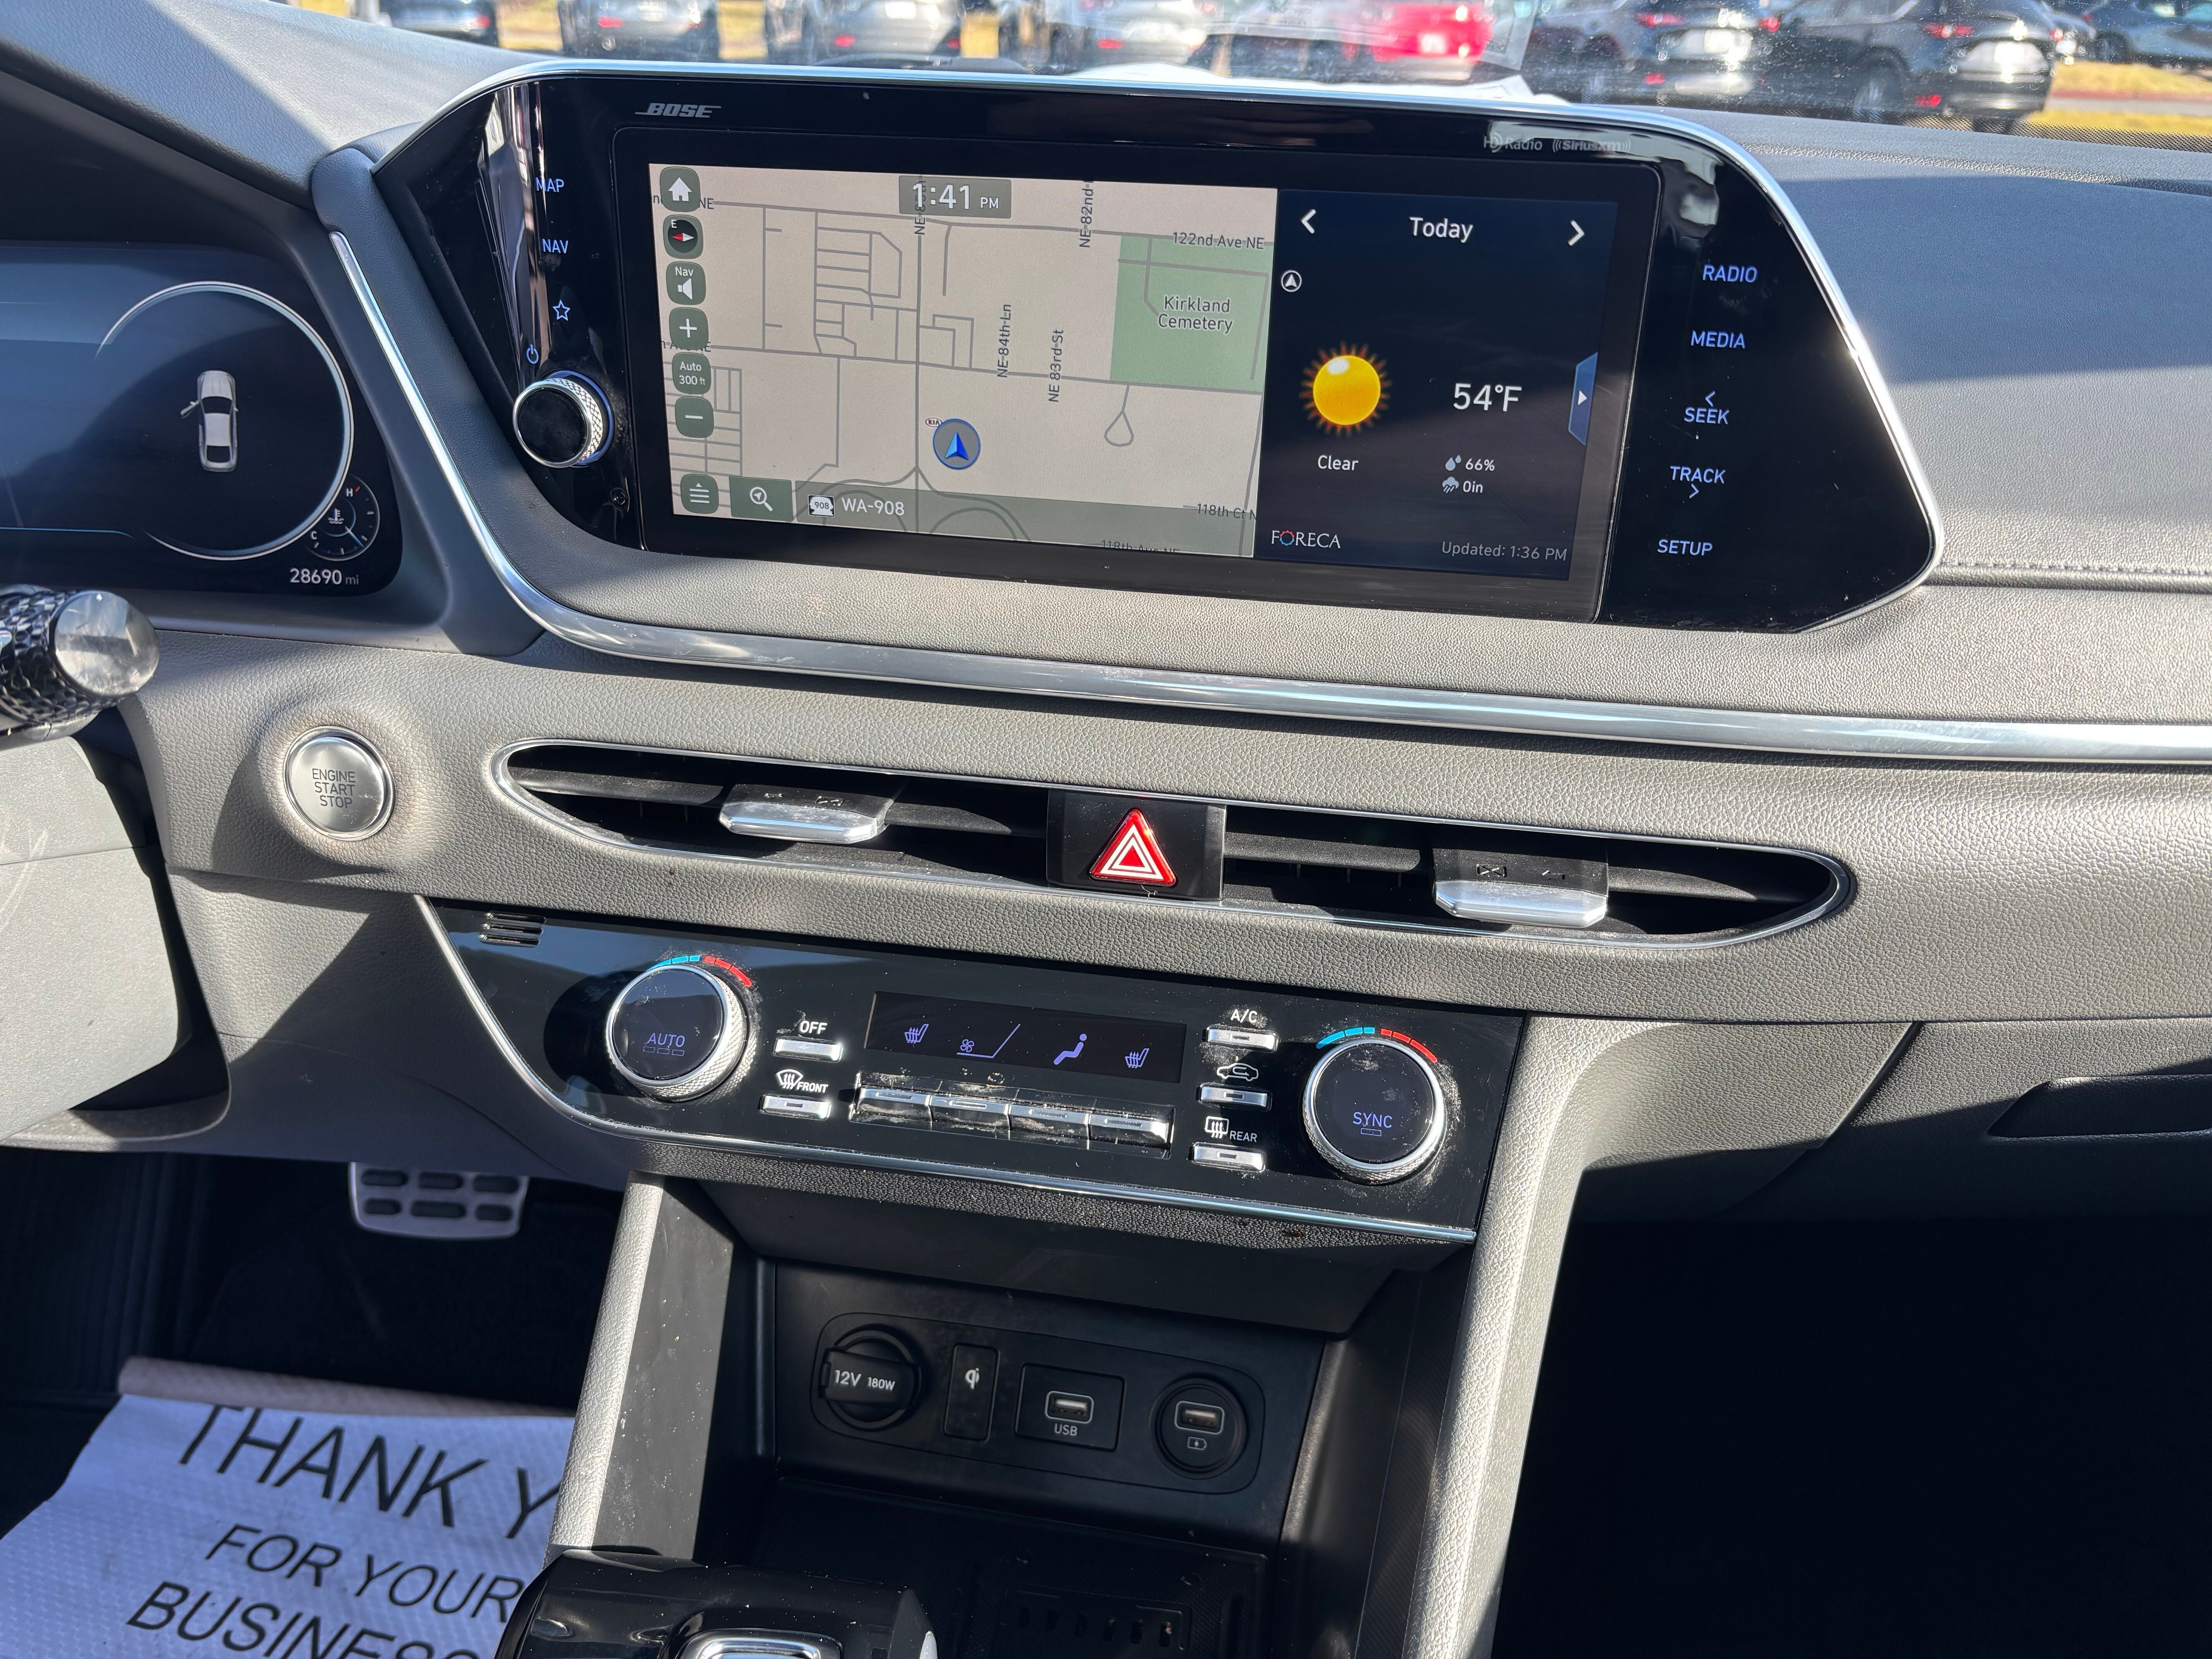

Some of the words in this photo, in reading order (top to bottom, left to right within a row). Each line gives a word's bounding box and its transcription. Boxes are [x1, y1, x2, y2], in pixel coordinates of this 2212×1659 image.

[635, 103, 721, 118] BOSE
[1506, 138, 1542, 151] Radio
[536, 177, 565, 192] MAP
[913, 183, 970, 210] 1:41
[981, 197, 999, 209] PM
[1081, 189, 1093, 224] 82nd
[671, 219, 677, 228] E
[914, 217, 925, 235] NE
[1410, 216, 1473, 243] Today
[542, 238, 568, 254] NAV
[1080, 229, 1091, 247] NE
[1173, 232, 1212, 246] 122nd
[1218, 235, 1242, 248] Ave
[1247, 237, 1264, 249] NE
[675, 267, 693, 276] Nav
[1703, 264, 1757, 283] RADIO
[1001, 304, 1011, 320] Ln
[1164, 296, 1230, 313] Kirkland
[1158, 314, 1233, 333] Cemetery
[999, 323, 1010, 356] 84th
[1053, 329, 1063, 344] St
[1691, 330, 1746, 349] MEDIA
[680, 362, 701, 371] Auto
[998, 361, 1008, 378] NE
[1051, 349, 1062, 380] 83rd
[679, 375, 697, 385] 300
[1049, 385, 1059, 402] NE
[1453, 383, 1522, 412] 54°F
[1684, 407, 1730, 424] SEEK
[1317, 455, 1359, 471] Clear
[1465, 459, 1495, 472] 66%
[1670, 466, 1726, 484] TRACK
[346, 488, 353, 497] H
[1463, 481, 1483, 494] 0in
[842, 497, 905, 515] WA-908
[1197, 503, 1228, 517] 118th
[1233, 508, 1245, 519] Ct
[311, 531, 317, 539] C
[1271, 529, 1341, 549] FORECA
[1442, 541, 1505, 557] Updated:
[1510, 545, 1540, 559] 1:36
[1546, 548, 1567, 561] PM
[1657, 539, 1713, 556] SETUP
[290, 567, 342, 584] 28690
[346, 575, 359, 585] mi
[312, 768, 356, 783] ENGINE
[314, 781, 356, 796] START
[319, 795, 353, 809] STOP
[1231, 1009, 1258, 1023] A/C
[799, 1020, 828, 1034] OFF
[647, 1032, 685, 1048] AUTO
[796, 1081, 828, 1094] FRONT
[1352, 1111, 1393, 1128] SYNC
[1229, 1130, 1257, 1143] REAR
[835, 1370, 862, 1387] 12V
[868, 1377, 895, 1391] 180W
[1054, 1424, 1078, 1436] USB
[179, 1405, 489, 1527] THANK
[205, 1523, 343, 1587] FOR
[354, 1553, 526, 1623] YOUR
[127, 1580, 482, 1659] BUSINE
